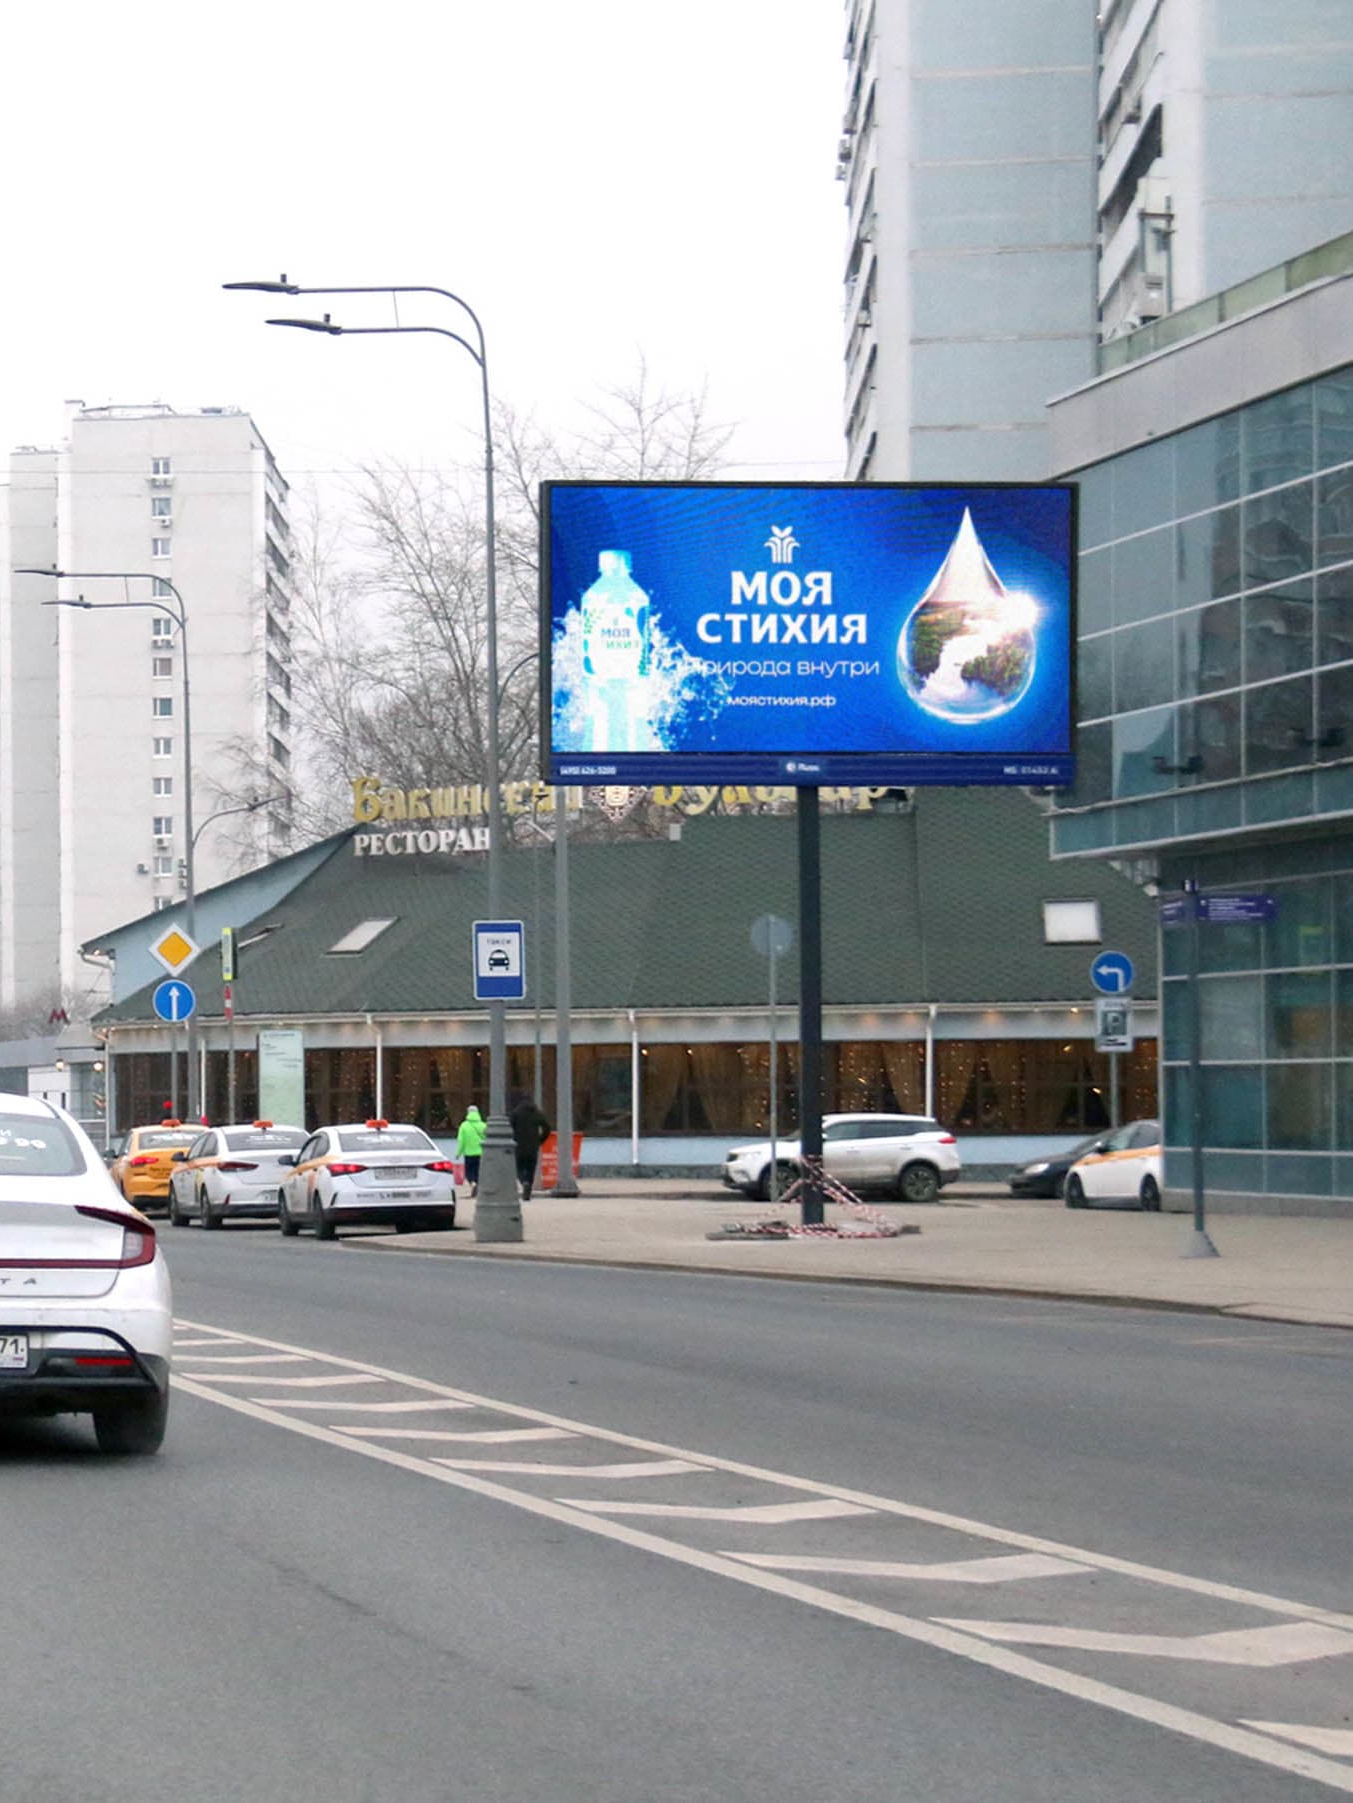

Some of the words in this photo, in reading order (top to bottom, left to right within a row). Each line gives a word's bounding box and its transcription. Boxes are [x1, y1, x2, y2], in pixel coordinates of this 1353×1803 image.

[730, 570, 833, 607] МОЯ
[696, 612, 868, 645] СТИХИЯ
[796, 659, 880, 679] внутри
[727, 693, 837, 708] моястихия.рф
[354, 827, 491, 857] РЕСТОРАН
